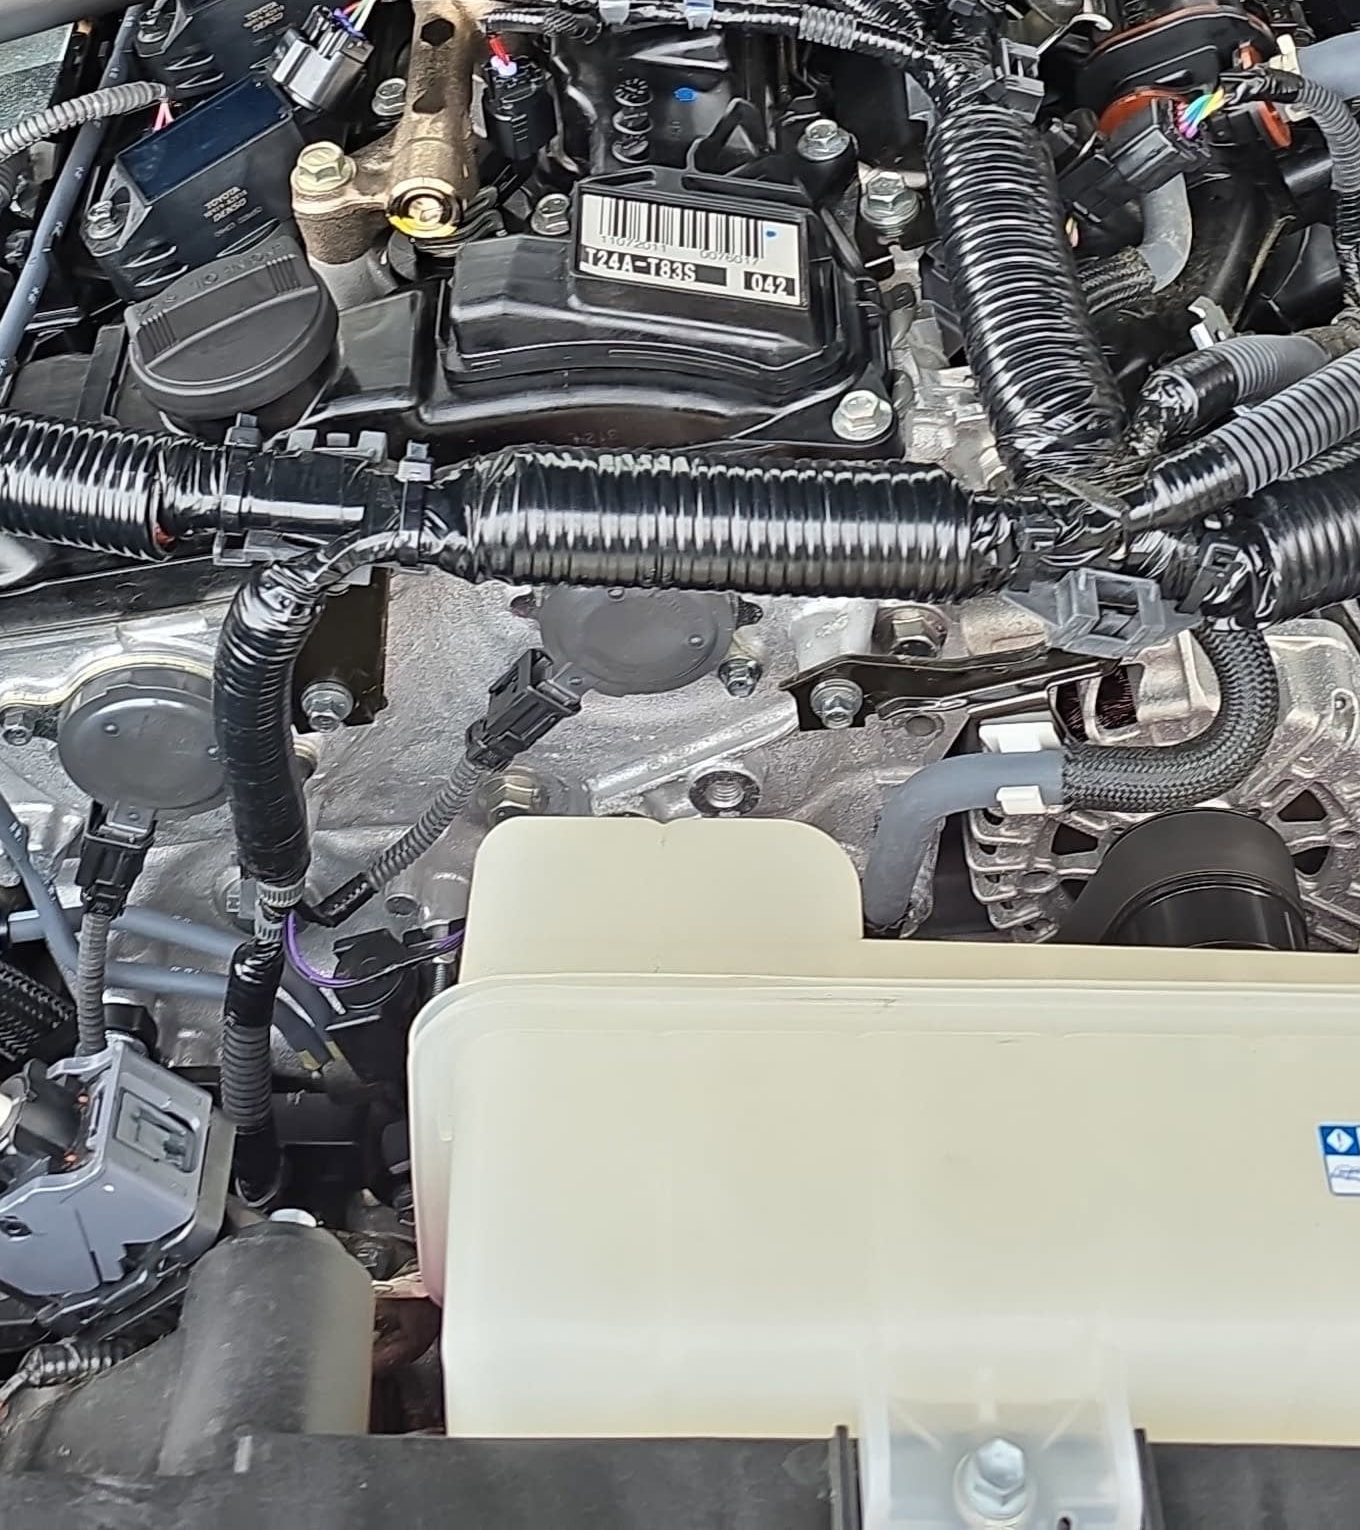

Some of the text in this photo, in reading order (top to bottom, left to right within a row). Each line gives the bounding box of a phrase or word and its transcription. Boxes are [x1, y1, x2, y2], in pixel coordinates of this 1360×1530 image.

[203, 186, 242, 210] TOYOTA
[212, 197, 247, 223] DENSO
[584, 246, 788, 296] T24A-T83S 042
